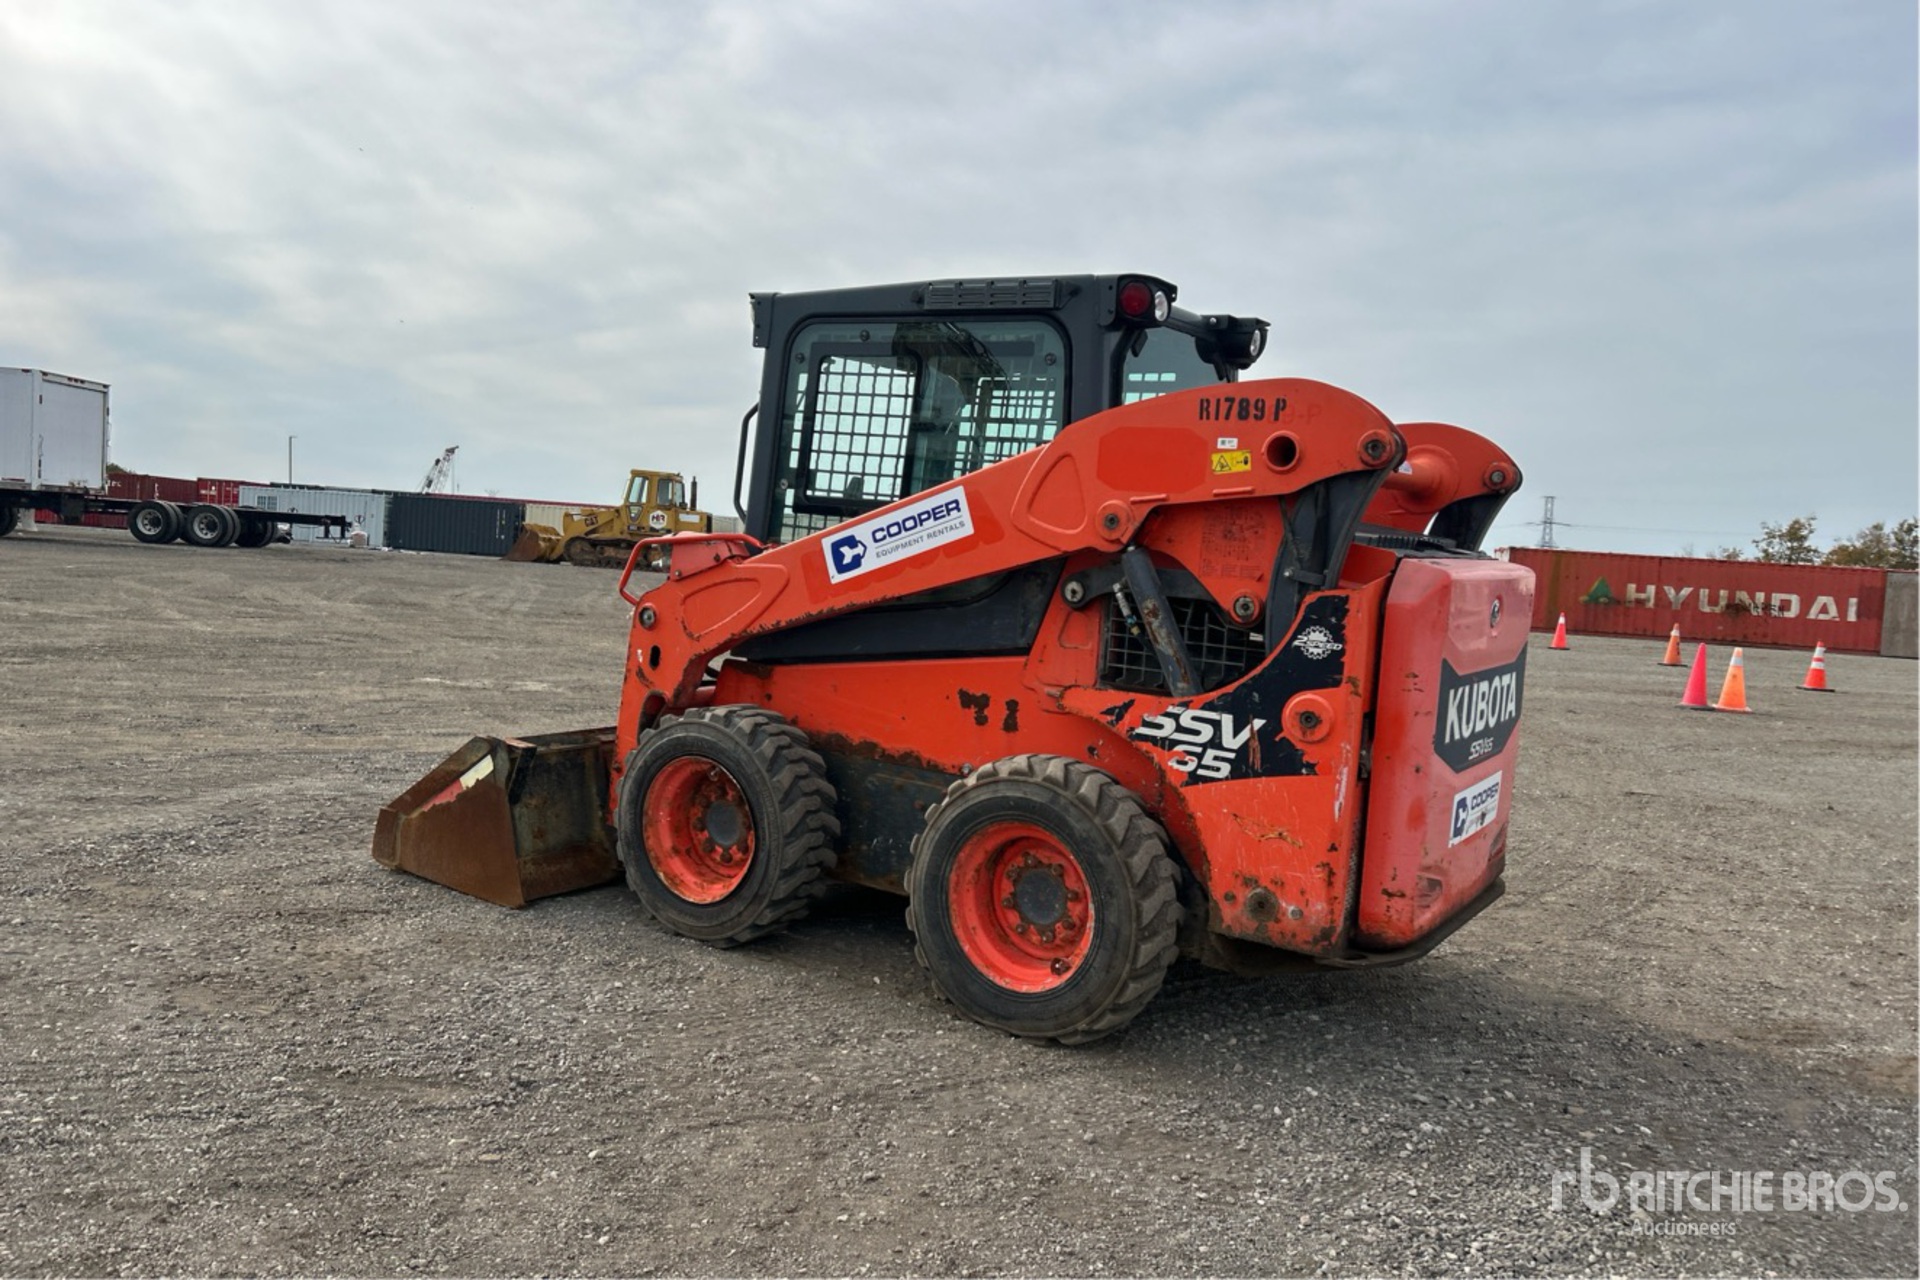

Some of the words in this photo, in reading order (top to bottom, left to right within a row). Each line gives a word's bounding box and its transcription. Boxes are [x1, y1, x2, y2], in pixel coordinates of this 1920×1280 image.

[871, 498, 962, 544] COOPER
[875, 533, 925, 558] EQUIPMENT
[926, 520, 966, 540] RENTALS
[1625, 583, 1859, 623] HYUNDAI
[1135, 704, 1267, 750] SSV
[1444, 671, 1517, 745] KUBOTA
[1168, 744, 1236, 779] 65
